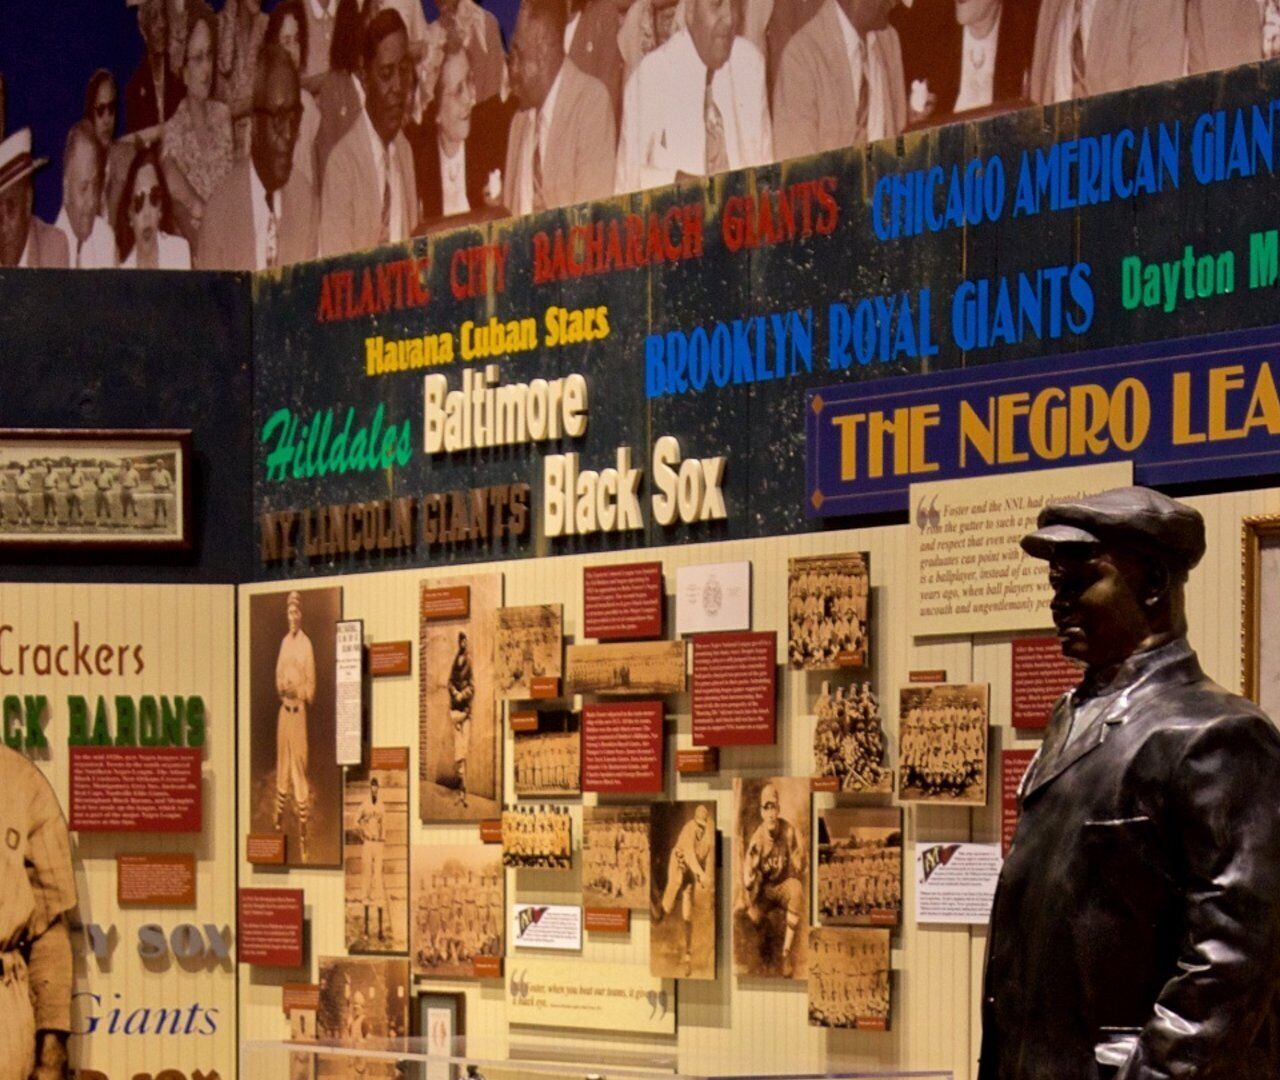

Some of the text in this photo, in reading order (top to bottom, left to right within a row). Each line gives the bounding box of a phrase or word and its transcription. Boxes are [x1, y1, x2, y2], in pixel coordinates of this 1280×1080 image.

[872, 156, 1005, 241] CHICAGO
[1013, 121, 1180, 217] AMERICAN
[318, 178, 839, 322] ATLANTIC CITY BACHARACH GIANTS
[1121, 249, 1235, 314] Dayton
[366, 305, 610, 376] Havana Cuban Stars
[645, 263, 1094, 399] BROOKLYN ROYAL GIANTS
[261, 403, 414, 482] Hilldales
[423, 364, 588, 455] Baltimore
[832, 411, 940, 482] THE
[959, 375, 1151, 468] NEGRO
[305, 498, 417, 559] LINCOLN
[424, 483, 532, 545] GIANTS
[544, 436, 728, 538] Black Sox
[943, 504, 969, 517] Foster
[971, 500, 987, 514] and
[989, 501, 1002, 512] the
[920, 535, 1005, 553] and respect that even
[67, 694, 207, 748] BARONS
[137, 922, 232, 960] SOX
[70, 992, 220, 1036] Giants
